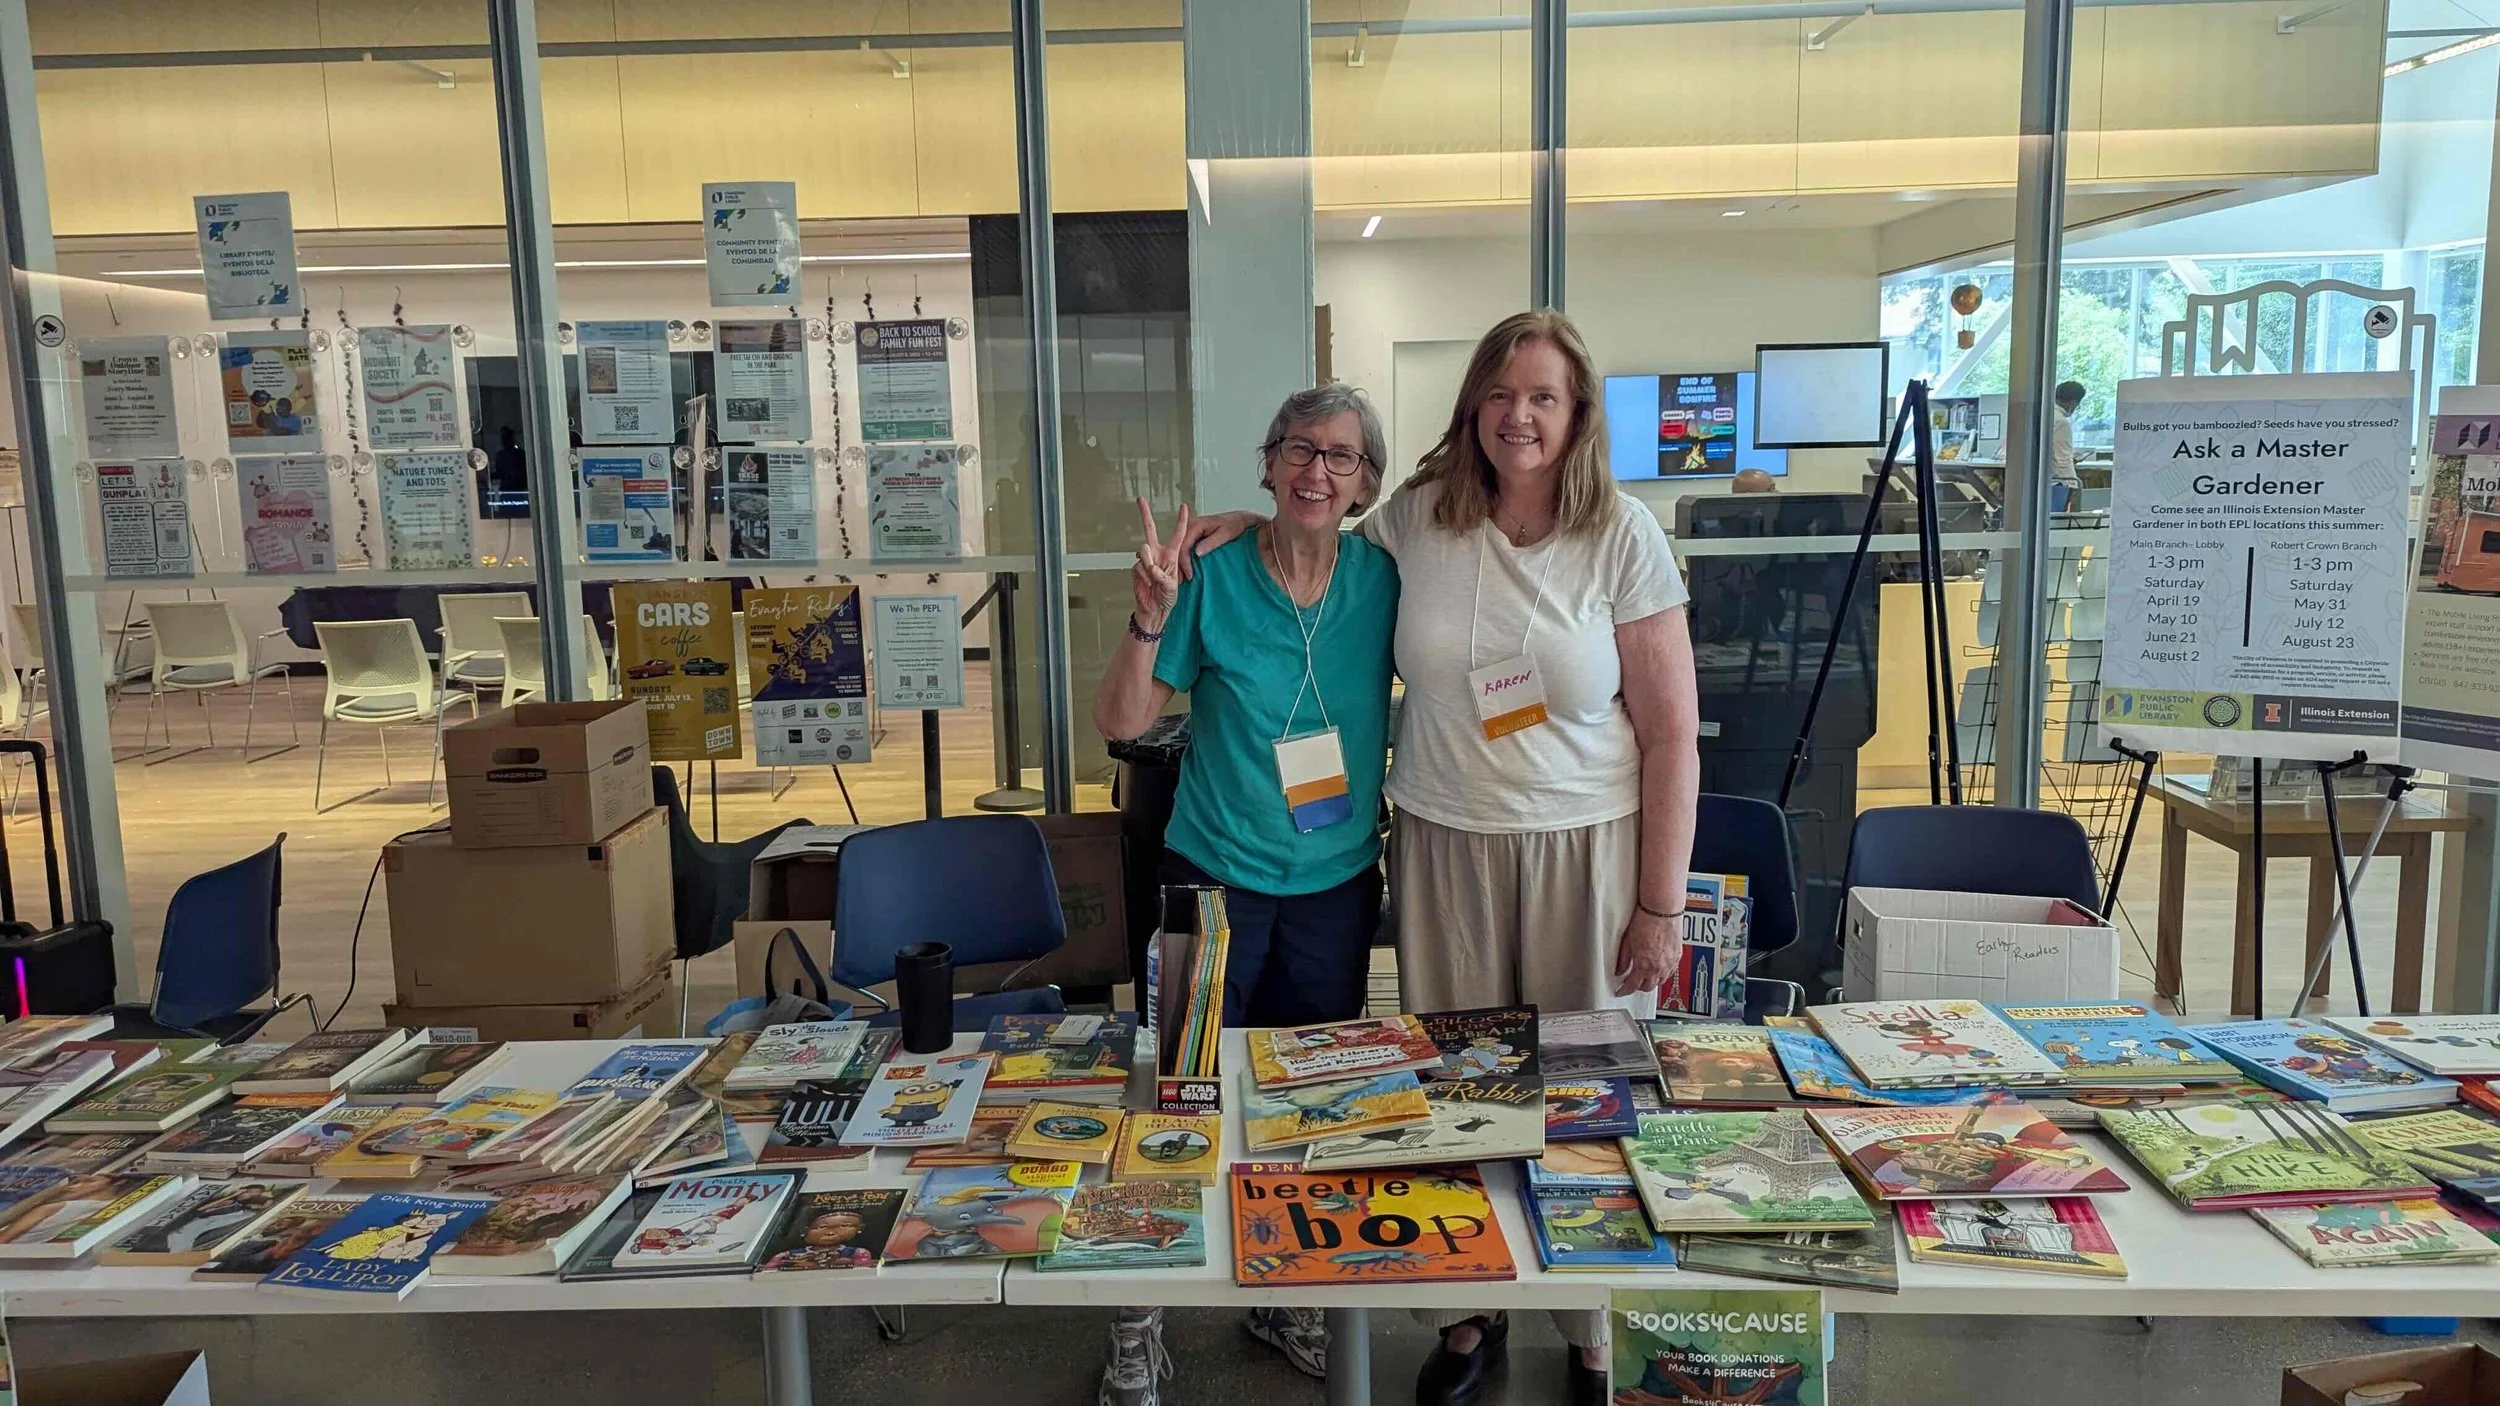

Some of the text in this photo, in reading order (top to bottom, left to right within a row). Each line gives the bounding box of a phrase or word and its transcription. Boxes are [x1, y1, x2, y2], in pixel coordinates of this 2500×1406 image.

[231, 269, 270, 277] BIBLIOTECA
[880, 325, 941, 337] BACK TO SCHOOL
[880, 337, 942, 348] FAMILY FUN FEST
[368, 369, 400, 380] SOCIETY
[1680, 377, 1713, 385] END OF
[1677, 386, 1716, 394] SUMMER
[1679, 395, 1717, 403] BONFIRE
[2123, 418, 2399, 432] Bulbs got you bamboozled? Seeds have you stressed?
[2172, 437, 2350, 459] Ask a Master
[393, 467, 455, 476] NATURE TUNES
[101, 477, 133, 485] LET'S
[406, 478, 446, 487] AND TOTS
[2192, 474, 2325, 495] Gardener
[258, 508, 314, 519] ROMANCE
[2151, 504, 2365, 515] Come see an Illinois Extension Master
[2132, 519, 2384, 531] Gardener in both EPL locations this summer:
[2129, 539, 2153, 548] Main
[2195, 540, 2225, 550] Lobby
[2270, 541, 2377, 551] Robert Crown Branch
[2147, 556, 2205, 572] 1-3 pm
[2293, 557, 2353, 573] 1-3 pm
[2144, 576, 2205, 590] Saturday
[2289, 578, 2353, 593] Saturday
[750, 592, 798, 620] Evanston
[2147, 594, 2200, 608] April 19
[2294, 598, 2346, 612] May 31
[638, 602, 710, 628] CARS
[889, 605, 904, 613] We
[922, 604, 942, 612] PEPL
[2147, 613, 2197, 626] May 10
[2294, 616, 2344, 631] July 12
[660, 628, 703, 658] coffee
[2145, 631, 2197, 643] June 21
[2282, 635, 2355, 650] August 23
[2140, 649, 2200, 663] August 2
[2420, 651, 2450, 660] Services
[1484, 669, 1533, 696] KAREN
[630, 685, 672, 694] SUNDAYS
[663, 694, 680, 702] JULY
[2140, 694, 2194, 704] EVANSTON
[2140, 703, 2175, 712] PUBLIC
[2300, 707, 2390, 719] Illinois Extension
[2140, 712, 2180, 721] LIBRARY
[1492, 713, 1538, 736] VOLUNTEER
[707, 727, 732, 740] DOWN
[708, 734, 732, 748] TOWN
[1976, 939, 2016, 957] Early
[2013, 944, 2061, 963] Readers
[1840, 1005, 1969, 1025] Stella
[805, 1025, 850, 1034] Slouch
[1458, 1020, 1495, 1032] the
[1464, 1026, 1526, 1040] BEARS
[2207, 1030, 2241, 1038] BEST
[2212, 1033, 2296, 1046] STORYBOOK
[2239, 1041, 2279, 1049] EVER
[1289, 1057, 1316, 1065] How
[1339, 1047, 1390, 1059] Library
[1293, 1051, 1397, 1073] Saved Rapunzel
[1161, 1084, 1217, 1097] LEGO STAR
[1182, 1091, 1217, 1101] WARS
[1440, 1080, 1538, 1102] Rabbit
[1162, 1103, 1216, 1111] COLLECTION
[1638, 1120, 1717, 1136] Marielle
[1832, 1112, 1953, 1138] OLD PIRATE
[1891, 1126, 1946, 1136] FISH
[2367, 1121, 2488, 1141] CORN &
[1852, 1128, 1876, 1139] WHO
[1653, 1134, 1719, 1147] in Paris
[2245, 1153, 2294, 1165] THE
[1019, 1165, 1070, 1175] DUMBO
[2231, 1160, 2338, 1178] HIKE
[669, 1180, 782, 1201] Monty
[1242, 1176, 1411, 1200] beetle
[863, 1191, 890, 1200] Ford
[380, 1195, 488, 1210] Dick King-Smith
[1285, 1201, 1486, 1256] bop
[2307, 1220, 2449, 1245] AGAIN
[324, 1260, 386, 1272] LADY
[271, 1262, 409, 1284] LOLLIPOP
[1626, 1310, 1808, 1334] BOOKS4CAUSE
[1656, 1349, 1785, 1364] YOUR BOOK DONATIONS
[1668, 1363, 1777, 1378] MAKE A DIFFERENCE
